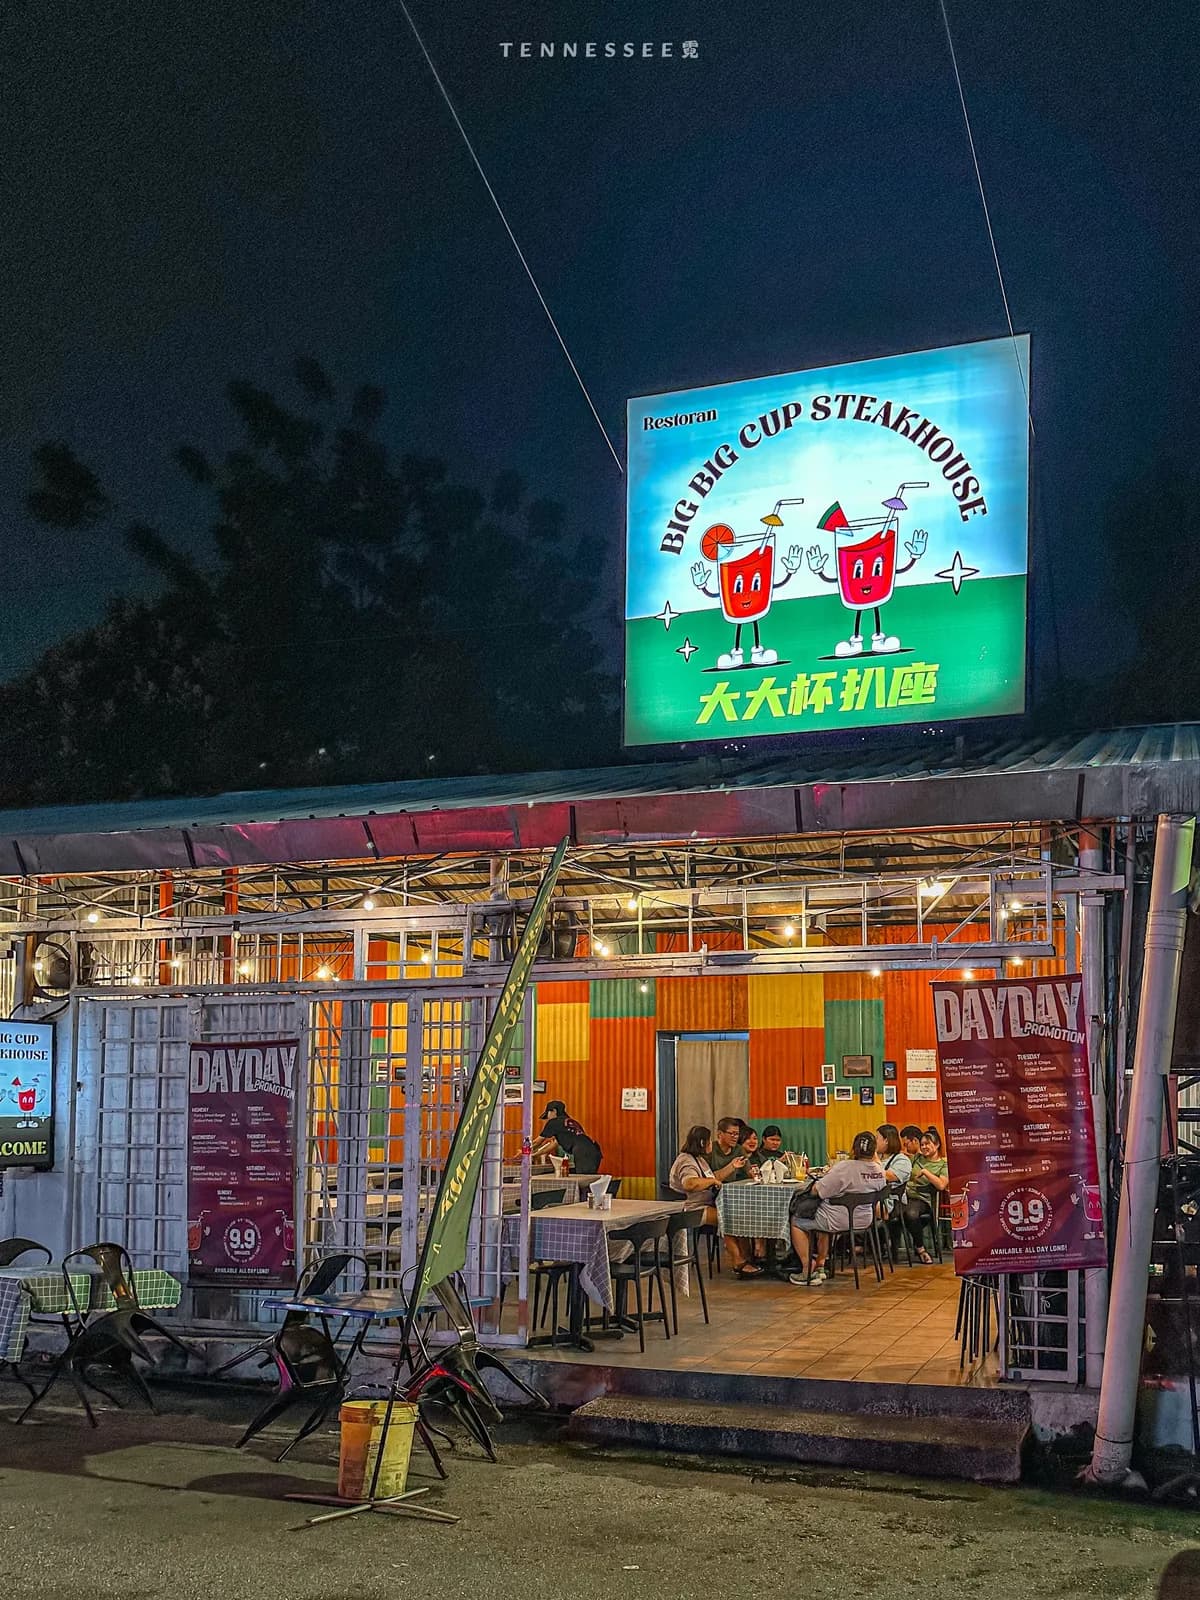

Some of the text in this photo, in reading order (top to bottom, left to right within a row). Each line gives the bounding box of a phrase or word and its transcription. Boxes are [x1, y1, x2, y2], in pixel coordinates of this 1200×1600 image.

[643, 408, 718, 431] Restoran
[659, 394, 988, 555] BIG BIG CUP STEAKHOUSE
[695, 662, 940, 724] 大大杯扒座
[934, 982, 1082, 1042] DAYDAY
[15, 1034, 40, 1045] CUP
[1024, 1022, 1086, 1044] PROMOTION
[1017, 1053, 1040, 1061] TUESDAY
[190, 1047, 297, 1093] DAYDAY
[254, 1079, 295, 1100] PROMOTION
[945, 1089, 977, 1098] WEDNESDAY
[1020, 1086, 1047, 1094] THURSDAY
[1023, 1123, 1051, 1131] SATURDAY
[0, 1141, 47, 1156] COME
[1007, 1199, 1044, 1225] 9.9
[229, 1228, 256, 1249] 9.9
[990, 1247, 1023, 1256] AVAILABLE
[1024, 1246, 1036, 1254] ALL
